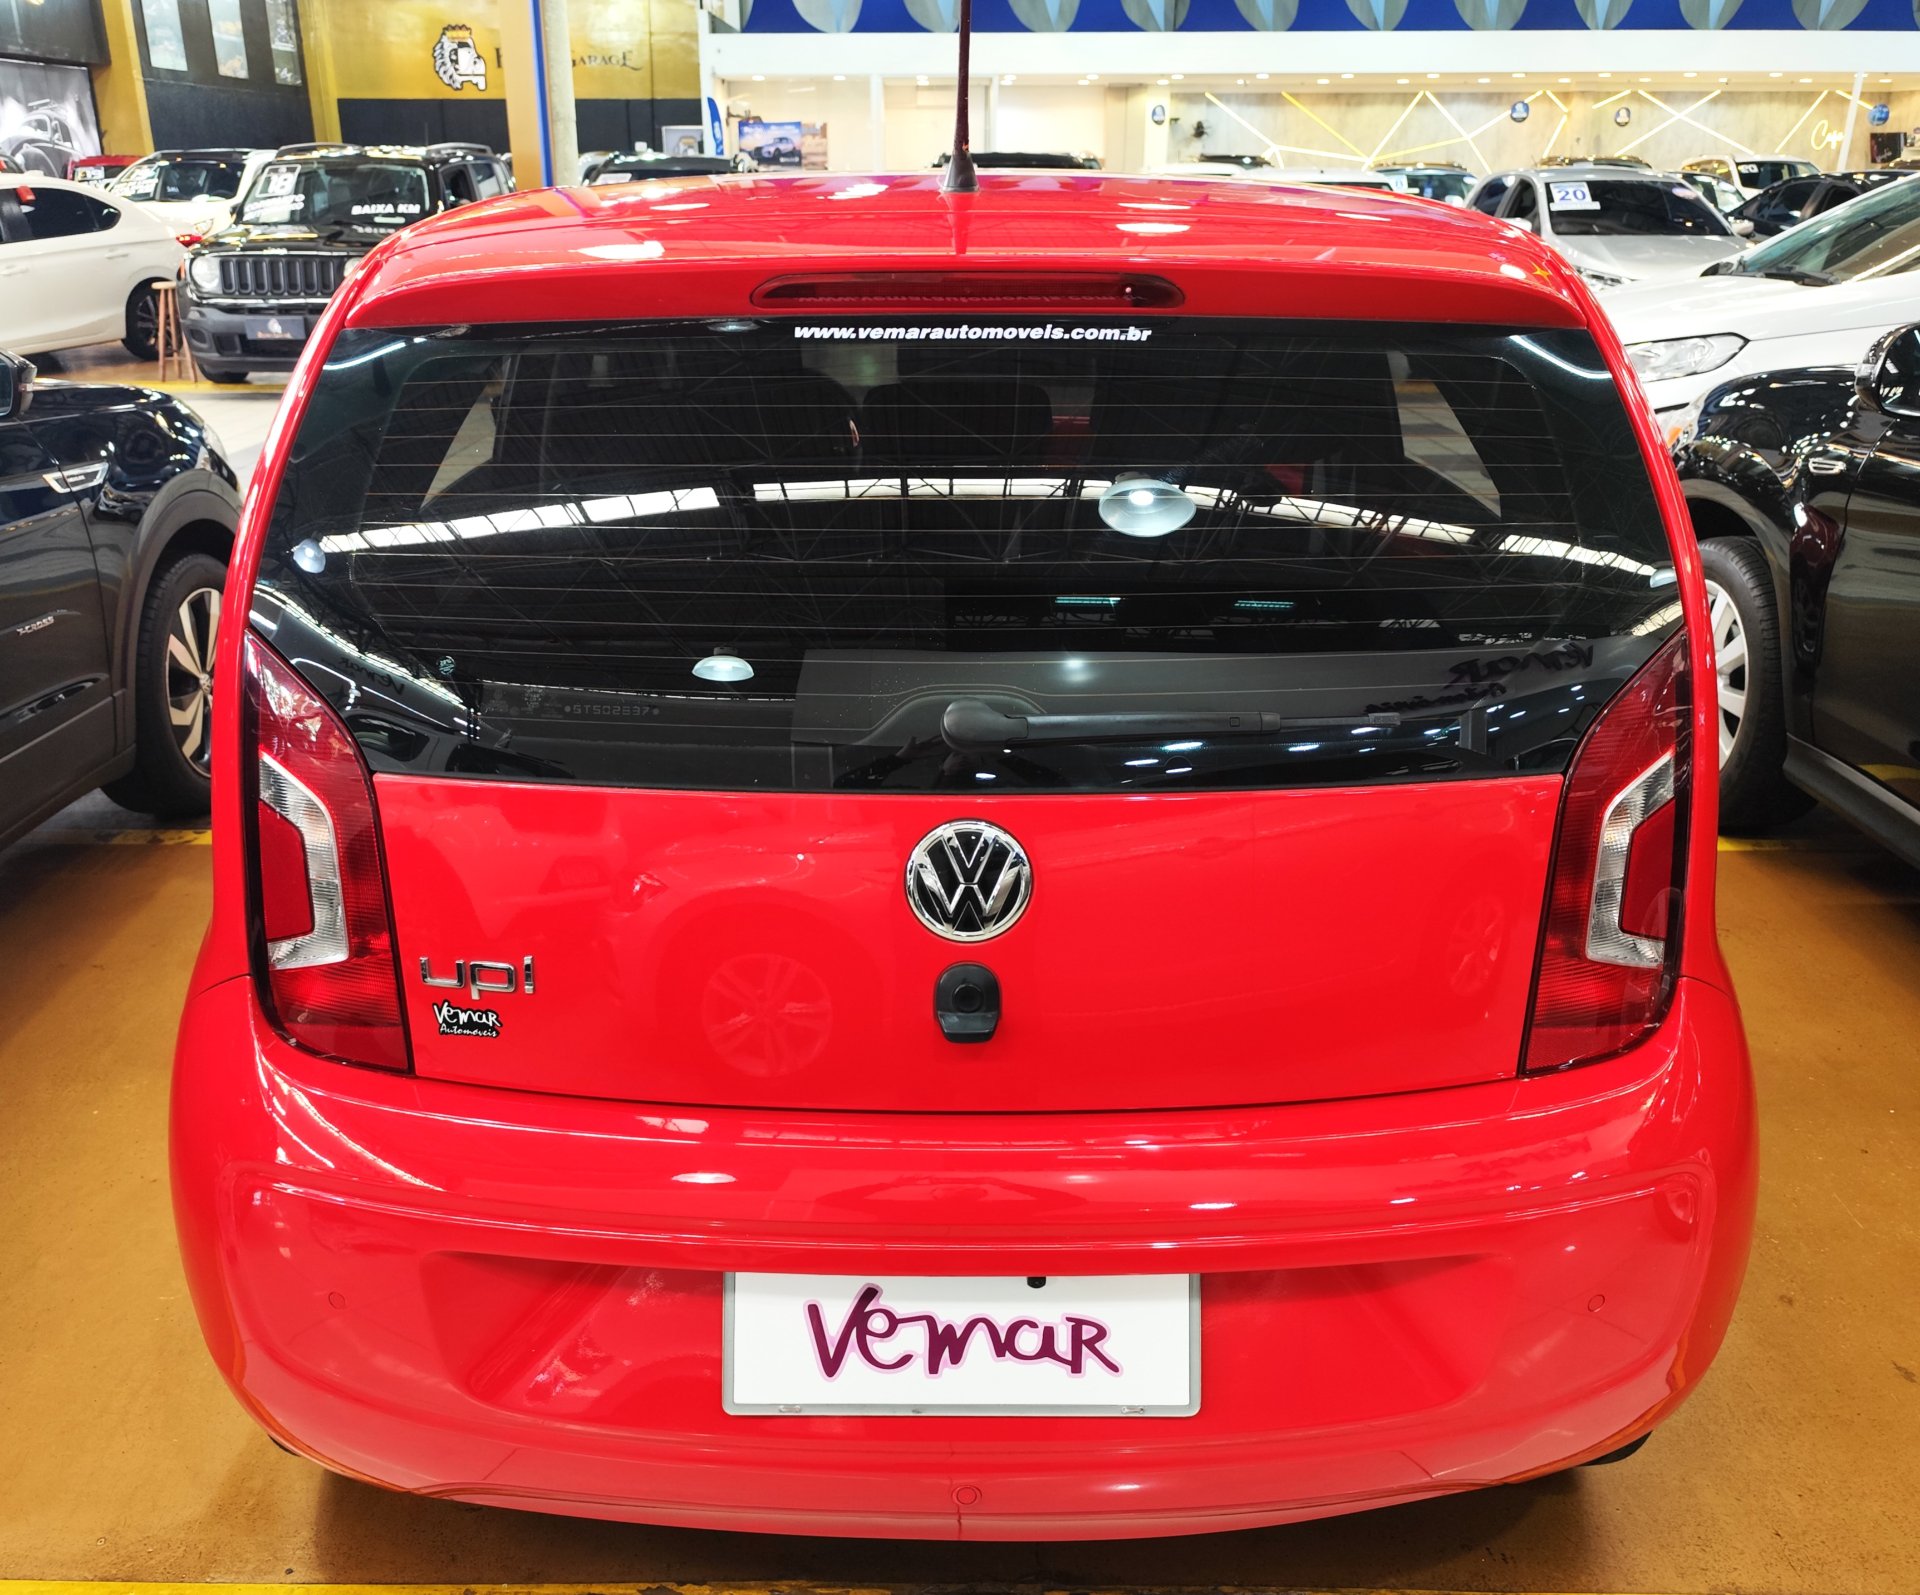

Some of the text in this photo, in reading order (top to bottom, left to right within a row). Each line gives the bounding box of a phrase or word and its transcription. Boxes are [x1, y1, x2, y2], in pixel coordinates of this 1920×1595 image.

[267, 173, 294, 194] 18
[1556, 189, 1586, 201] 20
[351, 204, 420, 215] BAIXA KM
[794, 325, 1152, 342] www.vemarautomoveis.com.br
[419, 955, 534, 1000] up!
